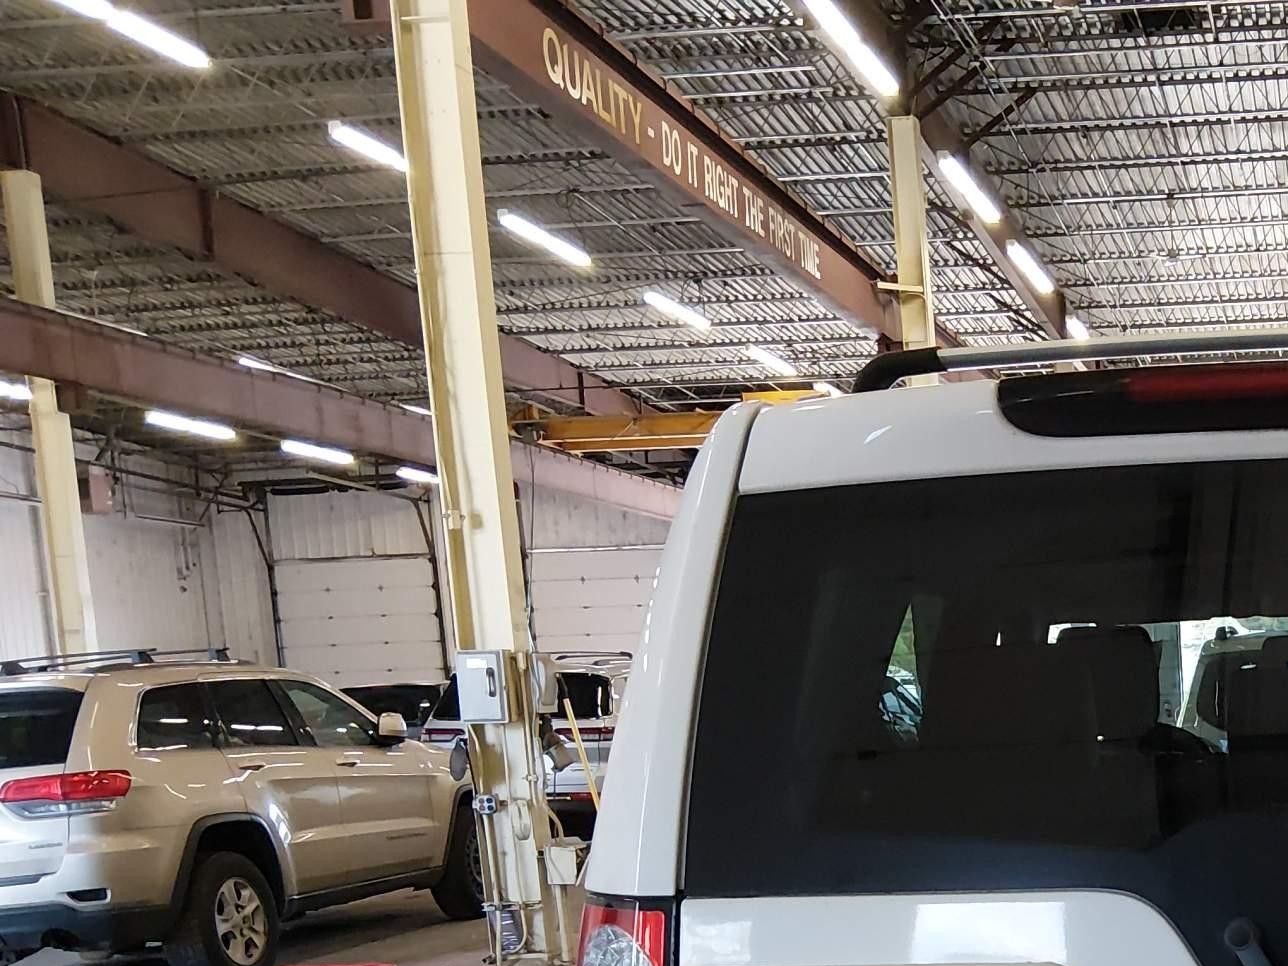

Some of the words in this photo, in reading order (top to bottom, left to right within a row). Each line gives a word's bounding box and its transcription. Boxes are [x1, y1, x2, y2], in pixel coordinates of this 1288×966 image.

[542, 26, 643, 145] QUALITY
[661, 121, 682, 176] DO
[687, 140, 699, 189] IT
[704, 154, 739, 219] RIGHT
[743, 184, 765, 237] THE
[769, 206, 796, 262] FIRST
[799, 230, 821, 280] TIME
